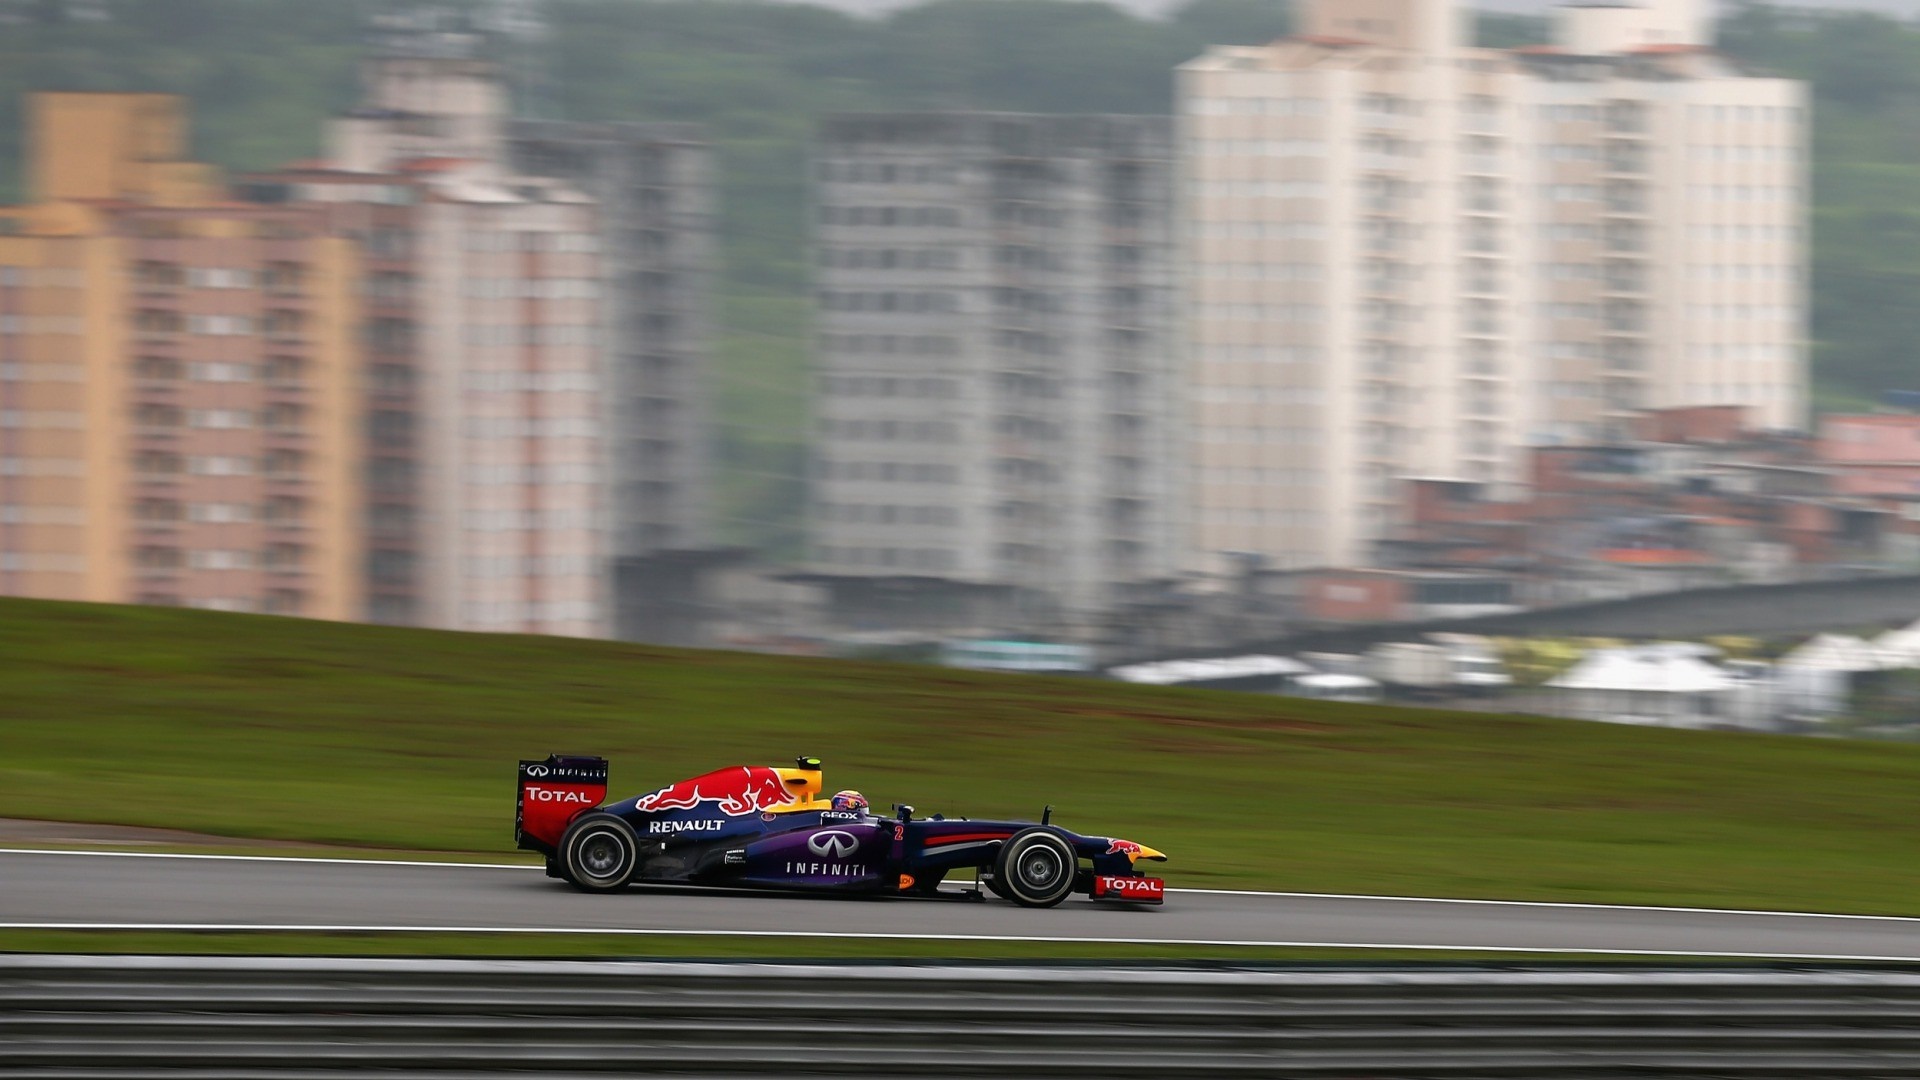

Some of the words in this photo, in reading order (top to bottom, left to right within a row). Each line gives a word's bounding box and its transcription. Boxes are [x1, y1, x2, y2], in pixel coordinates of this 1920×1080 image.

[553, 768, 606, 777] INFINITI
[526, 787, 592, 803] TOTAL
[821, 811, 858, 820] GEOX
[649, 820, 725, 833] RENAULT
[895, 825, 904, 841] 2
[786, 862, 866, 876] INFINITI
[1103, 877, 1161, 891] TOTAL
